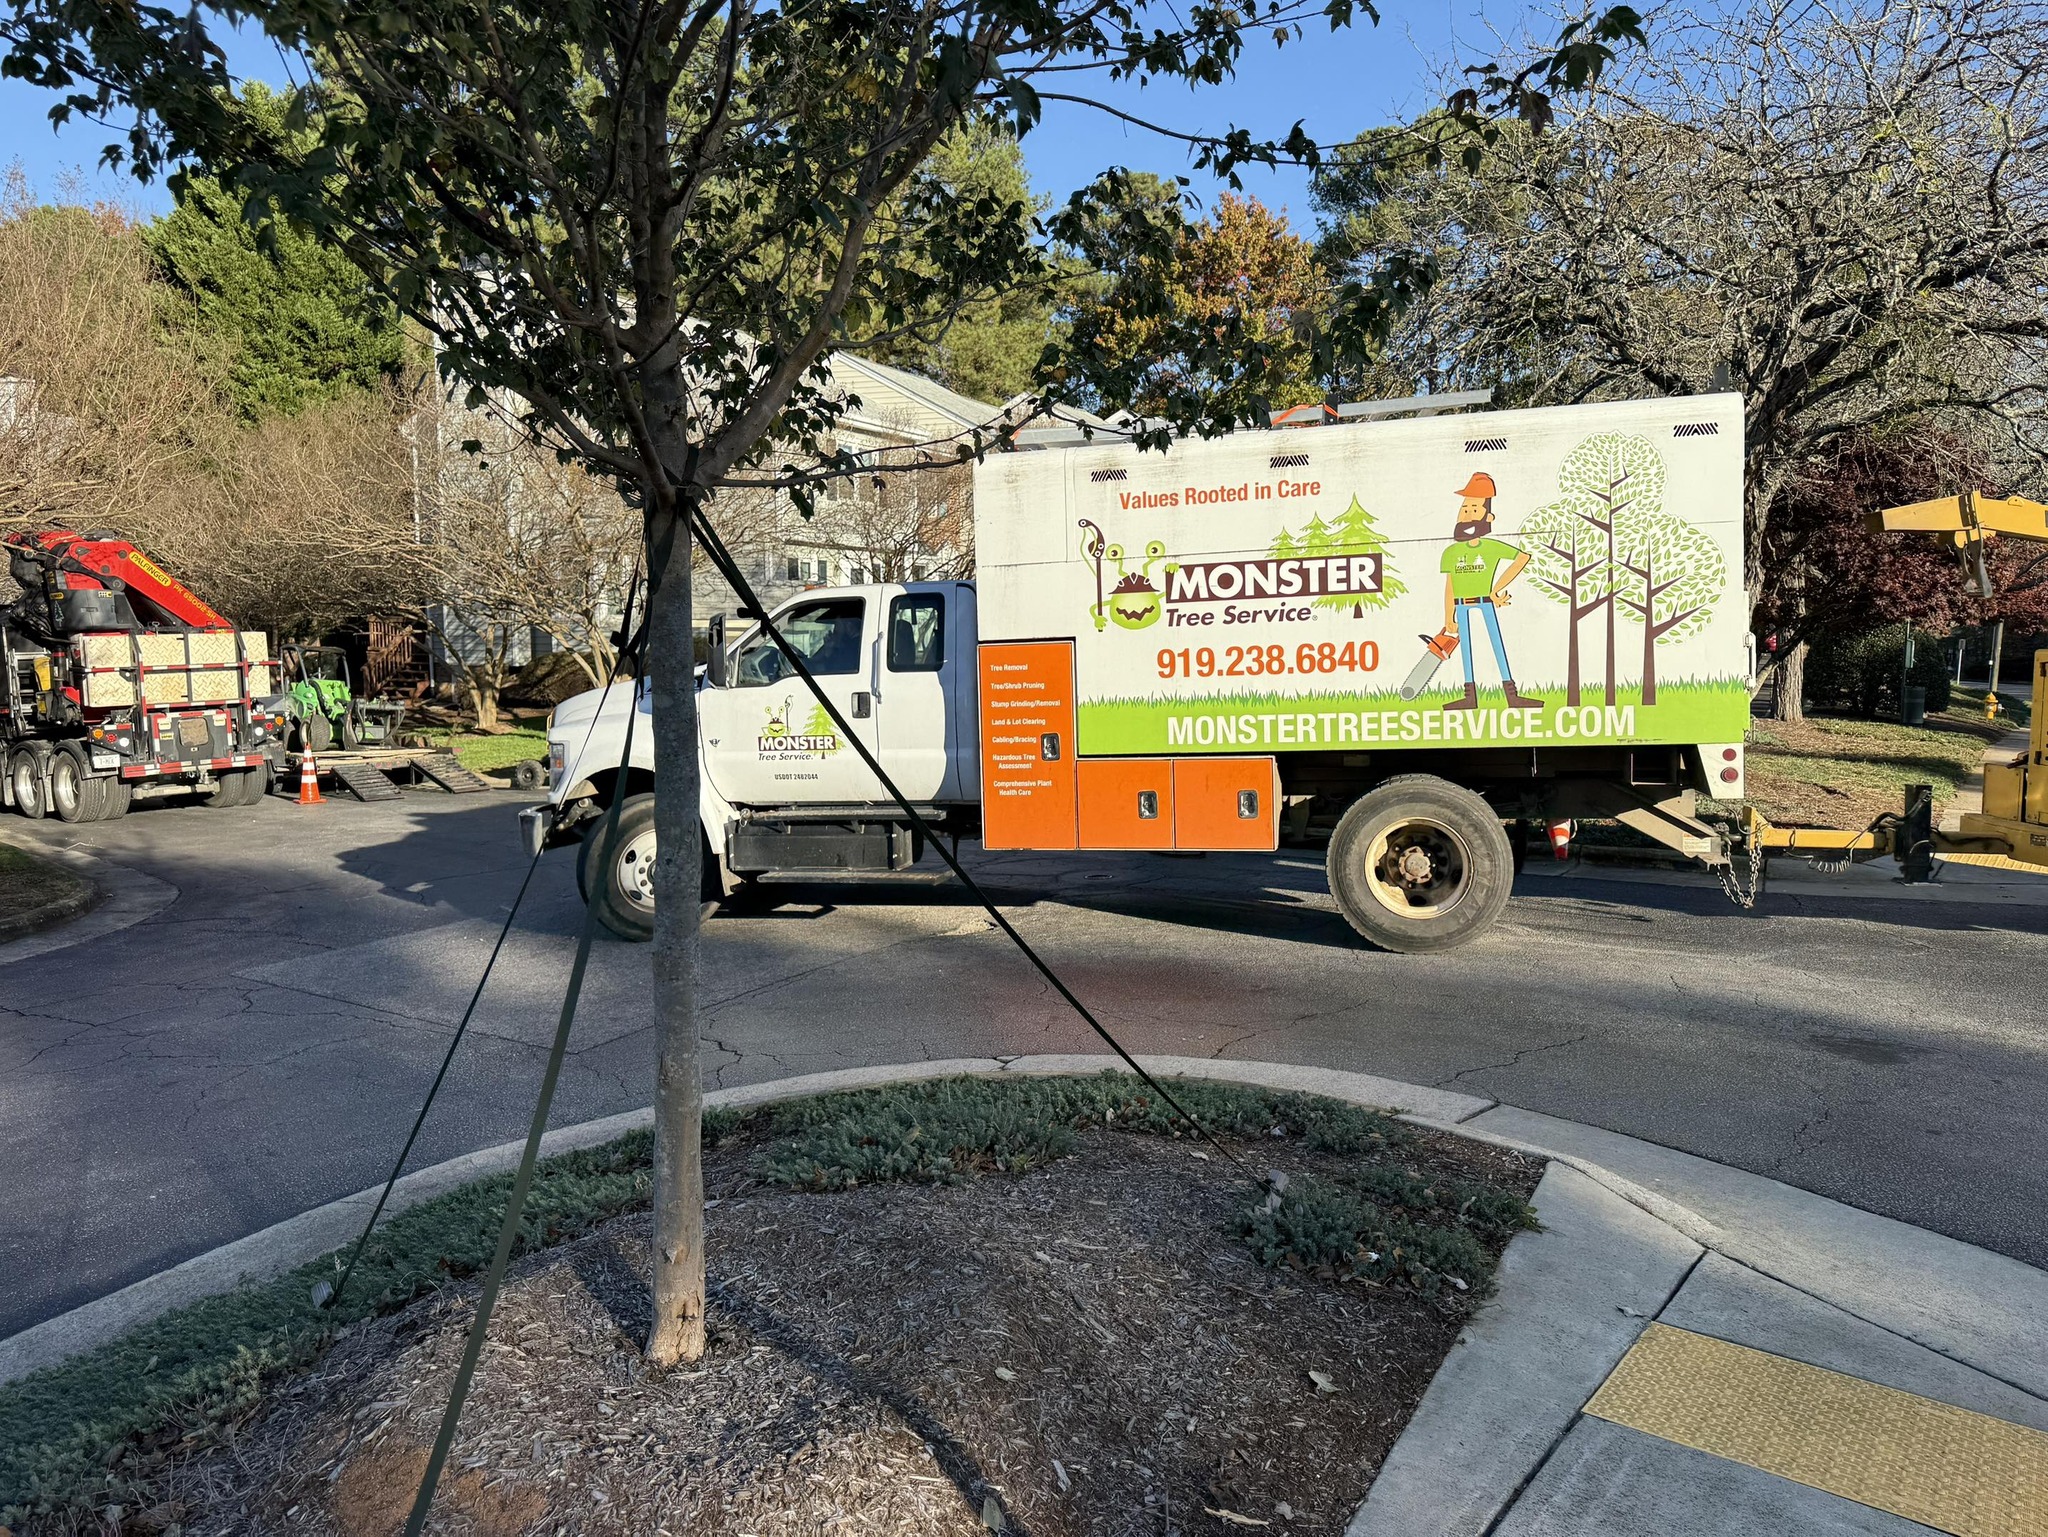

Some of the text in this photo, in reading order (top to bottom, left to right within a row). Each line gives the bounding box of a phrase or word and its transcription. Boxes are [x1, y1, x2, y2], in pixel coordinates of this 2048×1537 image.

[1119, 479, 1321, 510] Values Rooted in Care
[131, 553, 169, 585] PALFINGER
[1170, 555, 1379, 600] MONSTER
[173, 584, 183, 594] PK
[1166, 608, 1215, 627] Tree
[1157, 640, 1379, 679] 919.238.6840
[991, 681, 1045, 690] Tree/Shrub Pruning
[1010, 699, 1061, 708] Grinding/Removal
[991, 718, 1006, 726] Land
[1006, 718, 1011, 726] &
[1022, 717, 1046, 726] Clearing
[1167, 705, 1635, 745] MONSTERTREESERVICE.COM
[760, 736, 834, 751] MONSTER
[992, 736, 1037, 744] Cabling/Bracing
[758, 753, 777, 761] Tree
[993, 780, 1037, 788] Comprehensive
